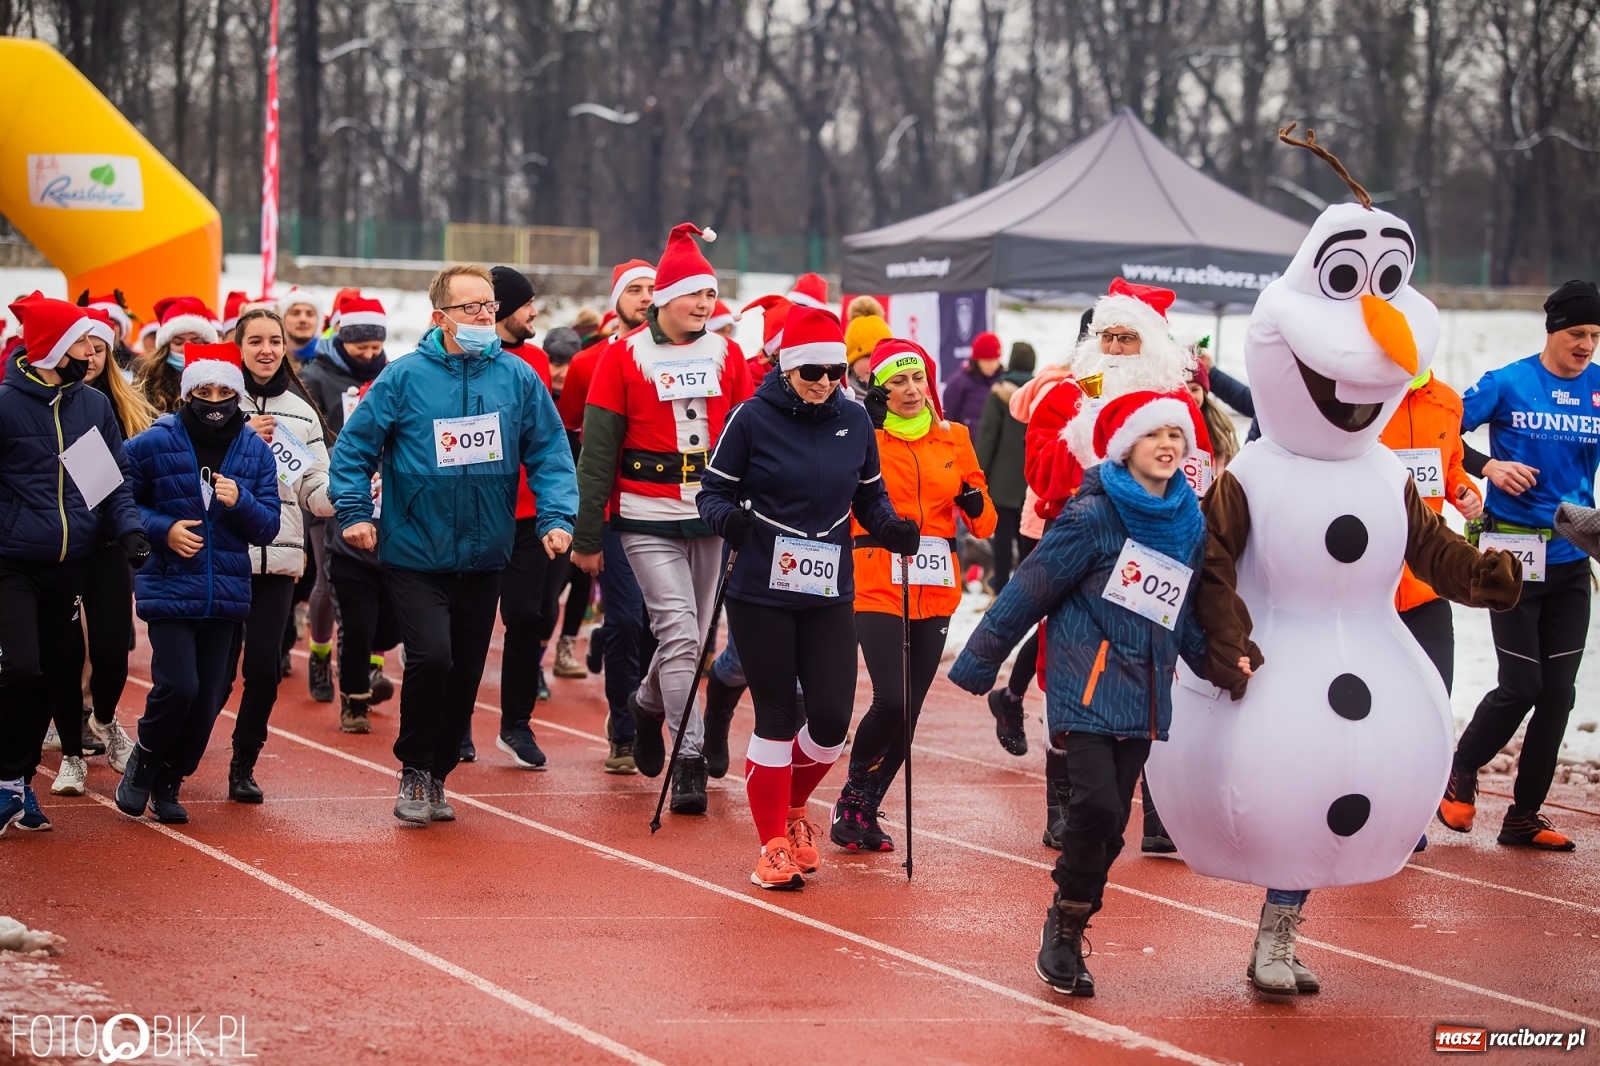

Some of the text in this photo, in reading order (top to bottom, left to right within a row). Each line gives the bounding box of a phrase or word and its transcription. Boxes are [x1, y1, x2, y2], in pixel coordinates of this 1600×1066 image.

[676, 371, 707, 386] 157
[460, 429, 495, 449] 097
[1578, 436, 1598, 444] TEAM
[270, 441, 302, 471] 090
[799, 558, 834, 580] 050
[915, 553, 947, 571] 051
[1142, 574, 1181, 608] 022
